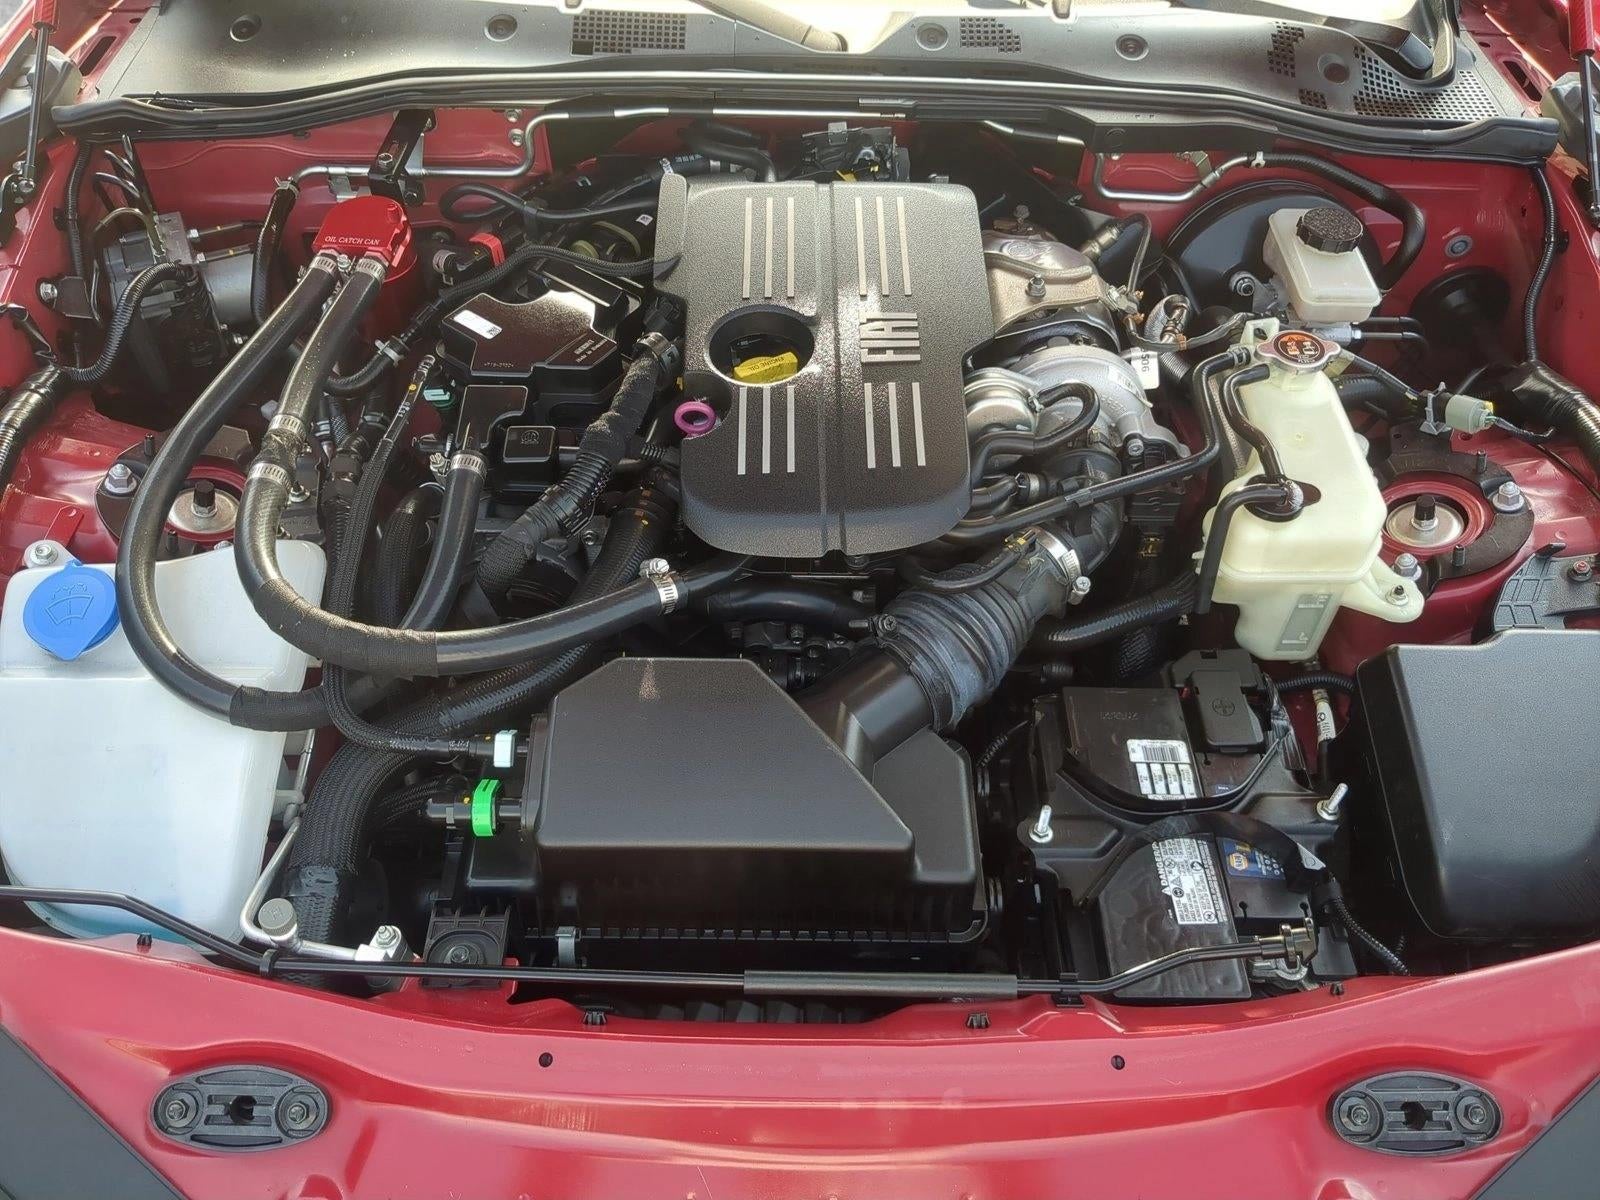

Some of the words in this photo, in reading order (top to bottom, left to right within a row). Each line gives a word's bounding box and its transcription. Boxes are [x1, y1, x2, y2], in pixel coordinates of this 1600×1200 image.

[324, 235, 337, 243] OIL
[338, 236, 363, 245] CATCH
[364, 238, 380, 246] CAN
[859, 310, 921, 363] FIAT
[759, 355, 785, 368] ENGINE
[747, 364, 760, 372] OIL
